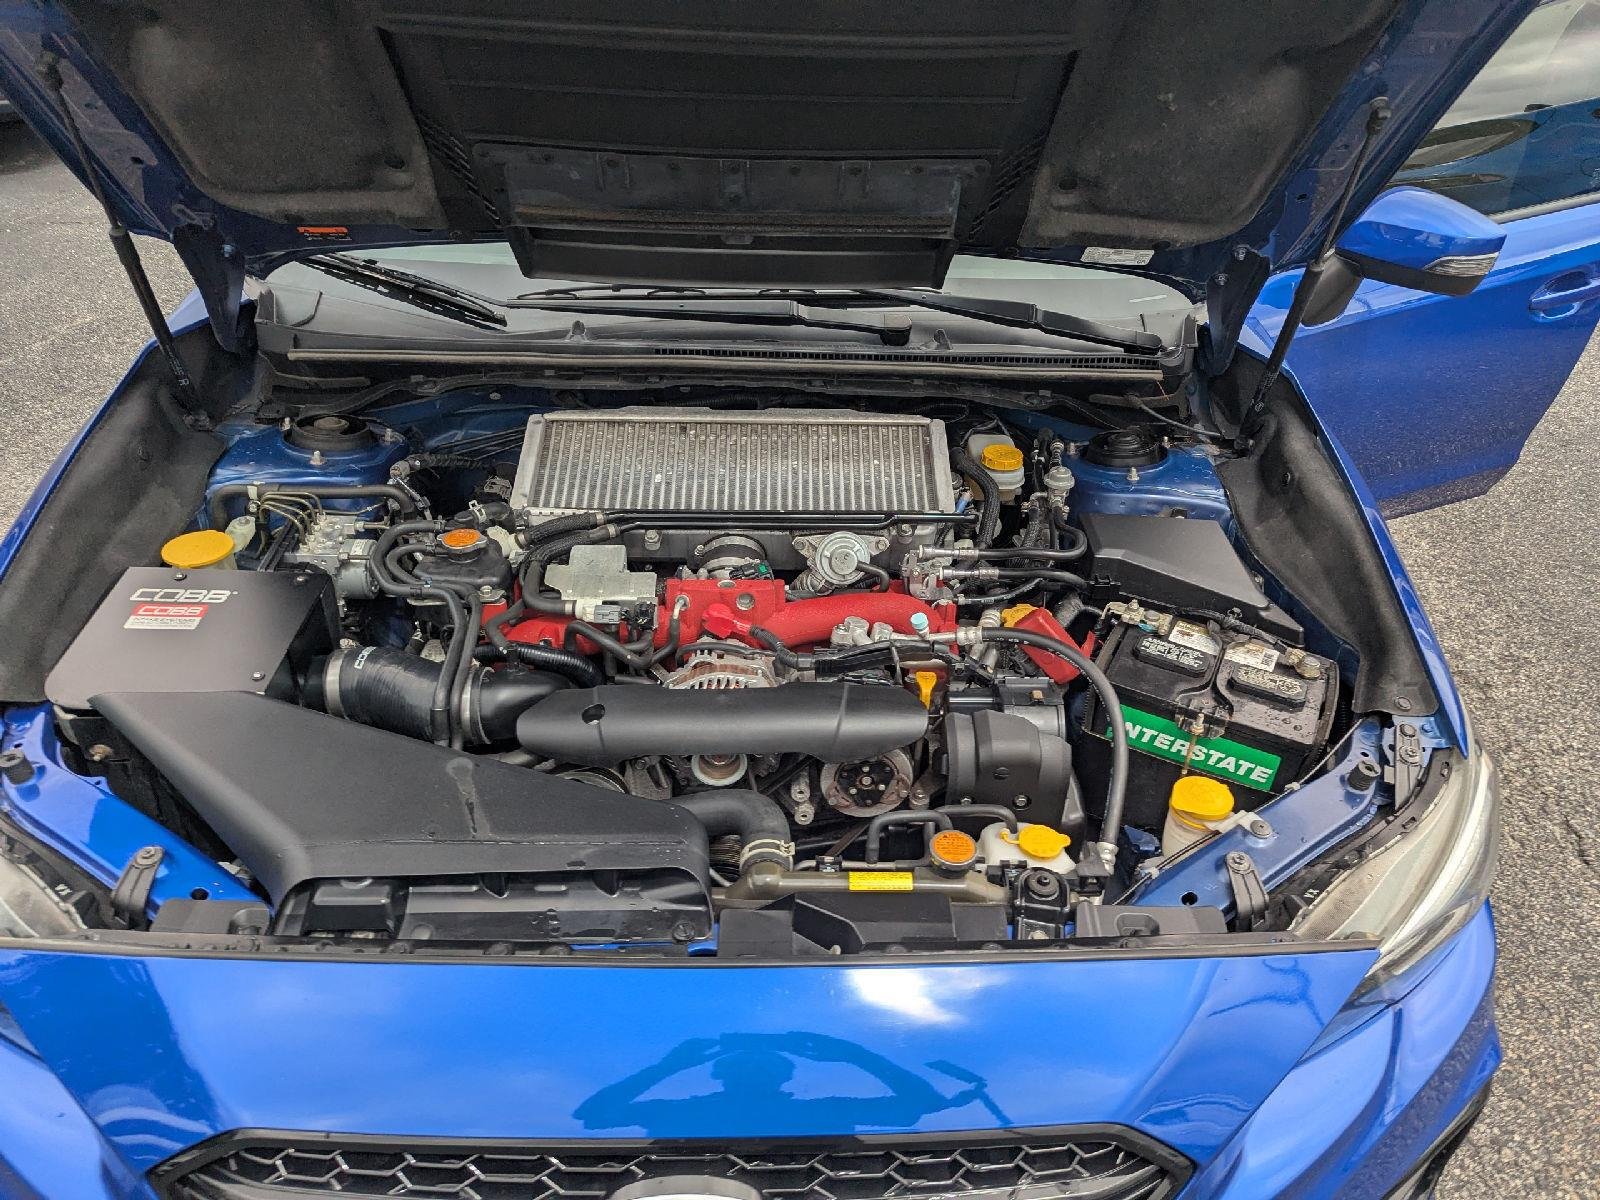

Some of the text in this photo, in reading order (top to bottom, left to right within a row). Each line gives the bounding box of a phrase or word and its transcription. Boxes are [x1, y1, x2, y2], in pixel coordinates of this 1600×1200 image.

[130, 588, 231, 603] COBB
[138, 606, 203, 616] COBB
[1124, 721, 1274, 783] NTERSTATE
